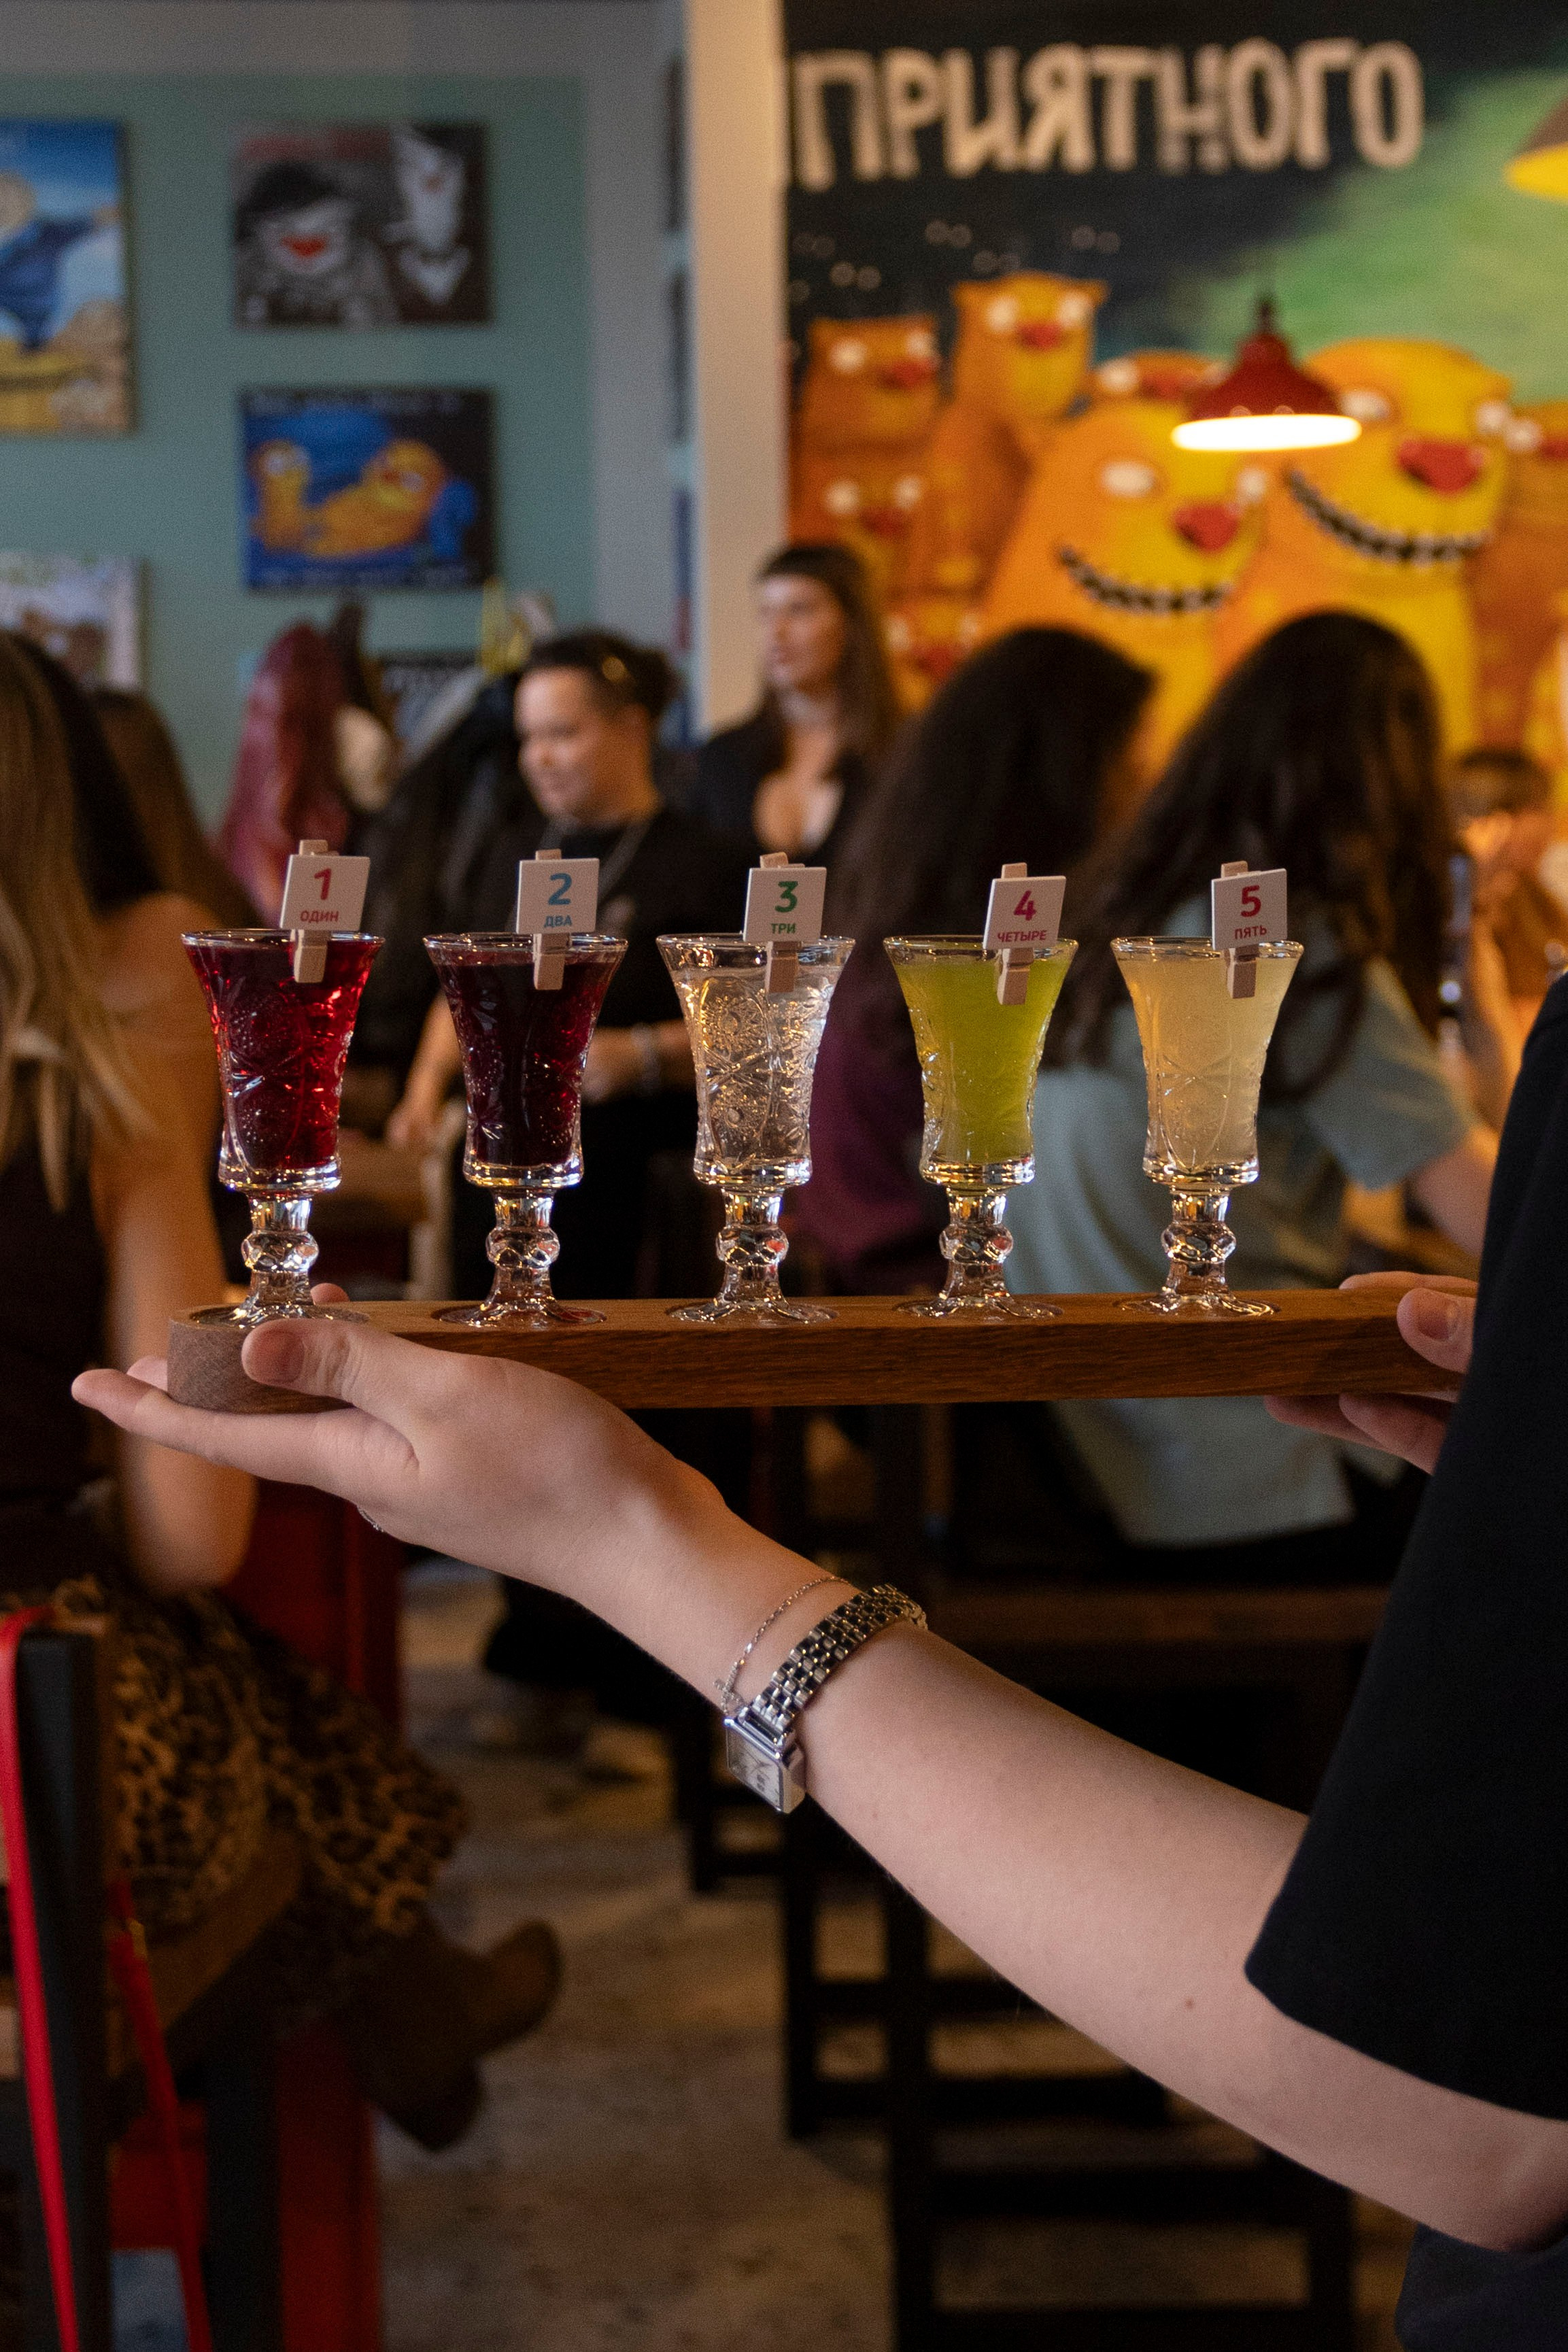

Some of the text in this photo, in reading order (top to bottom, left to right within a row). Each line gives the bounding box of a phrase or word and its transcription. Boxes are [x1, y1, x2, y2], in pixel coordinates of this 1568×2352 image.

[792, 37, 1425, 191] ПРИЯТНОГО
[314, 868, 333, 900] 1
[548, 872, 573, 906] 2
[774, 881, 798, 913] 3
[300, 909, 339, 923] ОДИН
[1014, 889, 1037, 921] 4
[1240, 885, 1261, 917] 5
[544, 915, 573, 928] ДВА
[770, 922, 796, 934] ТРИ
[997, 930, 1048, 942] ЧЕТЫРЕ
[1234, 925, 1267, 940] ПЯТЬ
